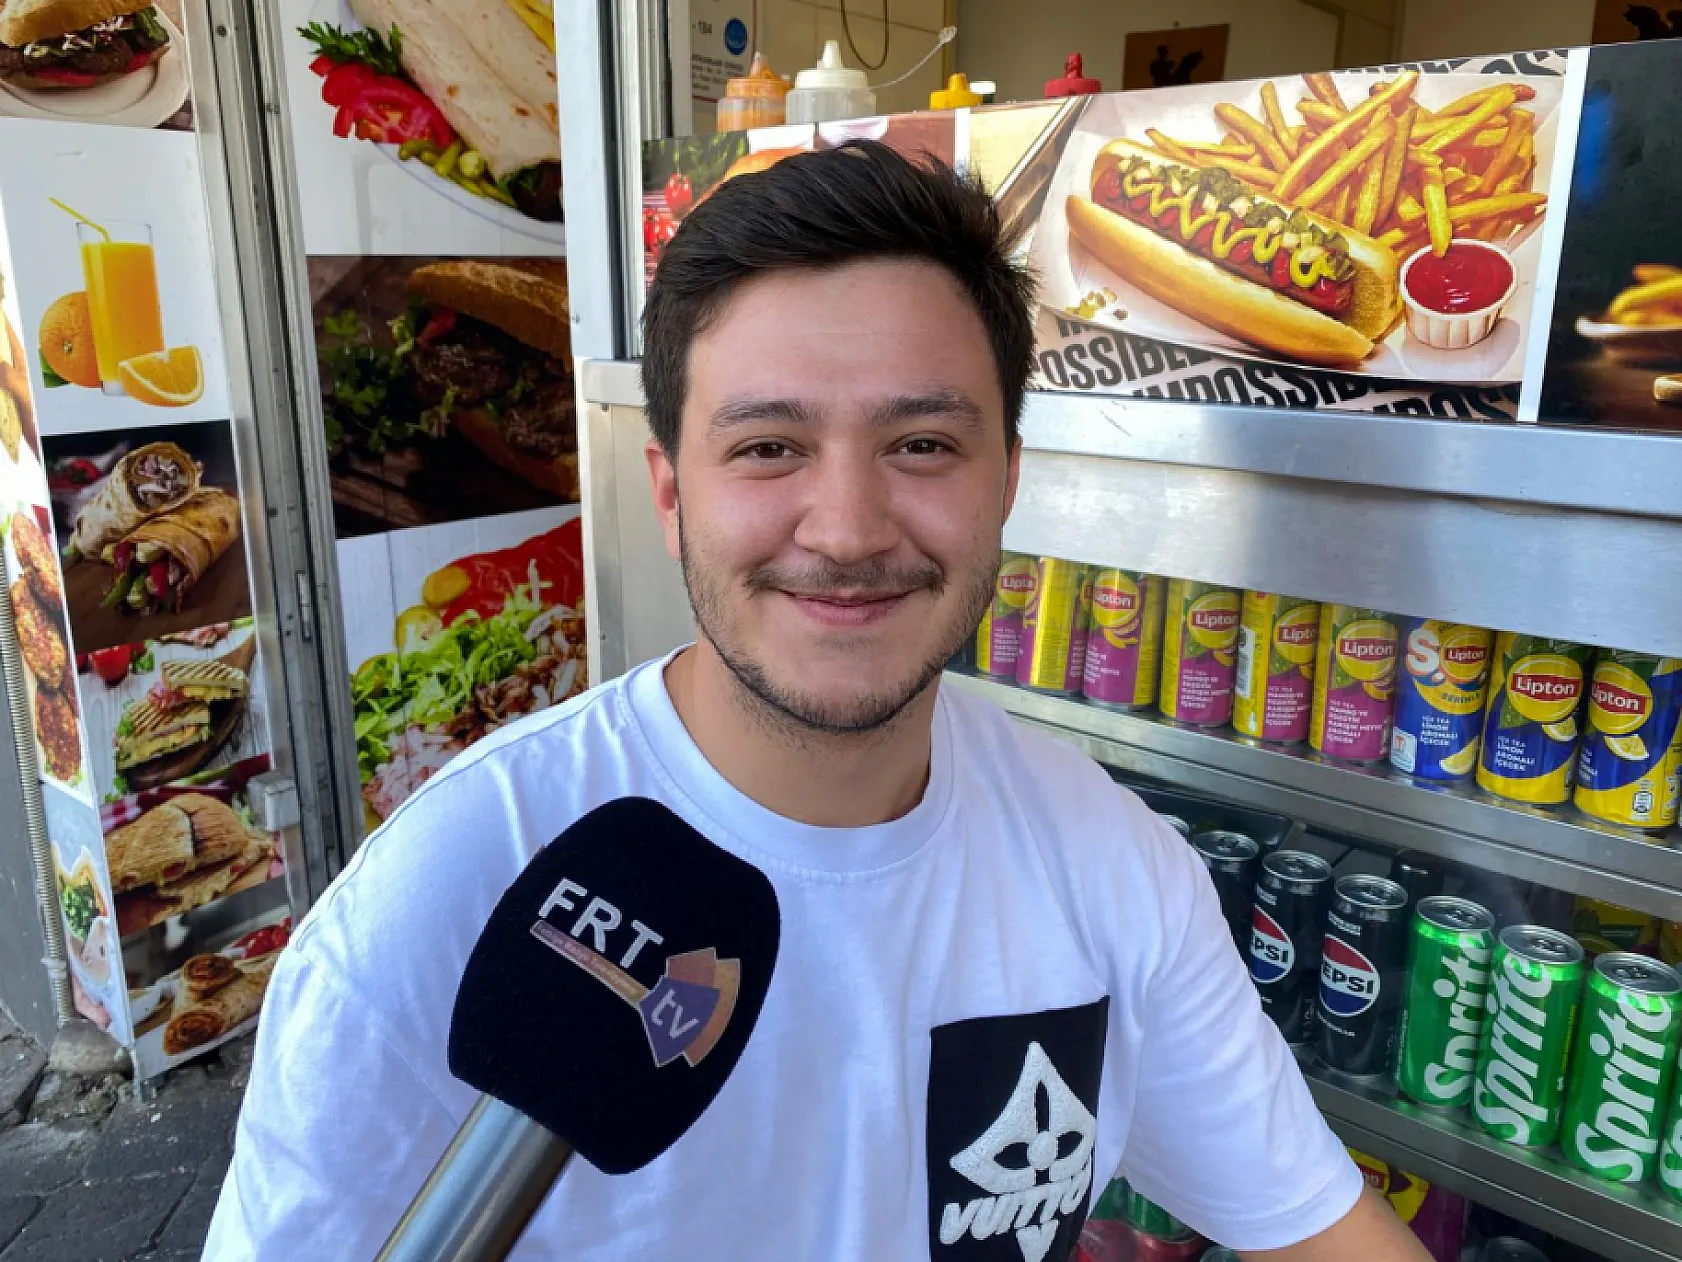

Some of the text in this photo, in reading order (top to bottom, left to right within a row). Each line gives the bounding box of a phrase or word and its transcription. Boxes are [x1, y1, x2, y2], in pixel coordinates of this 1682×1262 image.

[1344, 641, 1393, 657] Lipton
[1448, 648, 1484, 661] Lipton
[1515, 676, 1575, 696] Lipton
[538, 877, 664, 969] FRT
[651, 989, 700, 1039] tv
[1424, 929, 1492, 1099] Sprite
[1474, 952, 1552, 1146] Sprite
[1576, 989, 1672, 1182] Sprite
